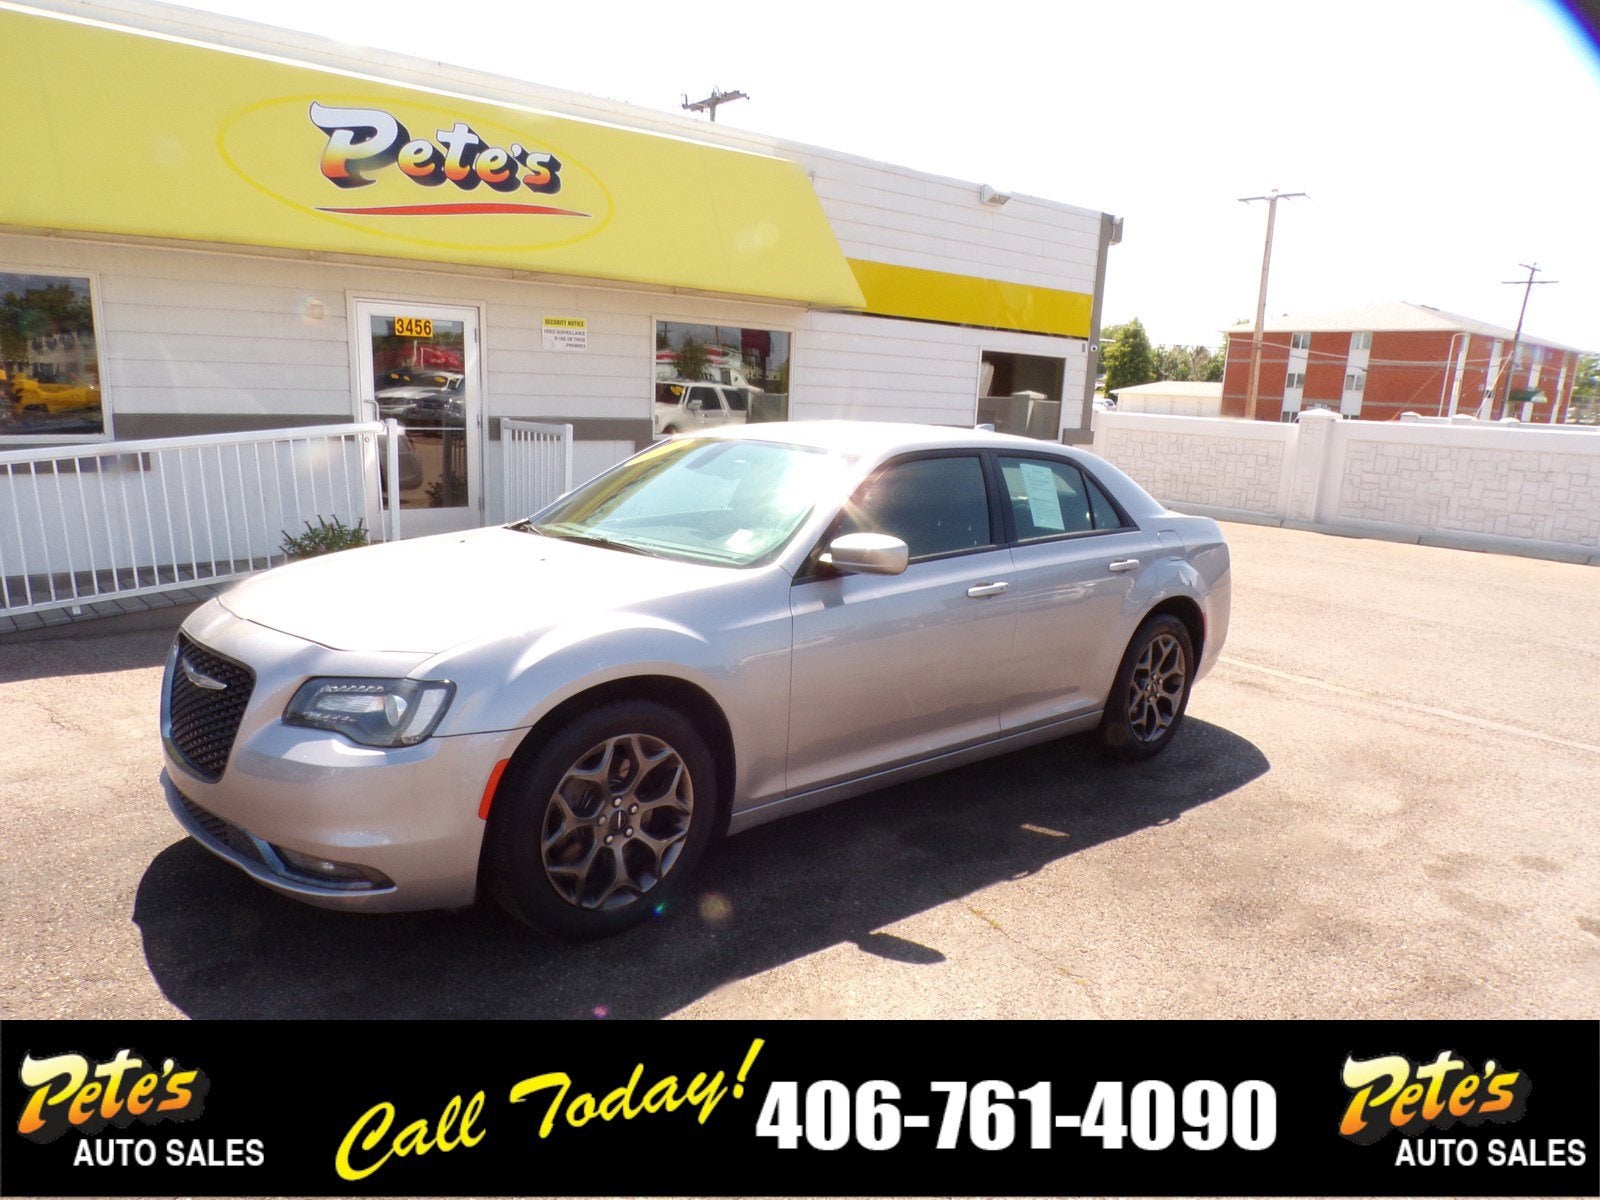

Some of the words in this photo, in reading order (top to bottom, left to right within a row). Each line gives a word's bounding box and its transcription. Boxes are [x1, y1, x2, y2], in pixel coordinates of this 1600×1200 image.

[308, 101, 562, 195] Pete's
[396, 318, 432, 336] 3456
[545, 318, 566, 326] SECURITY
